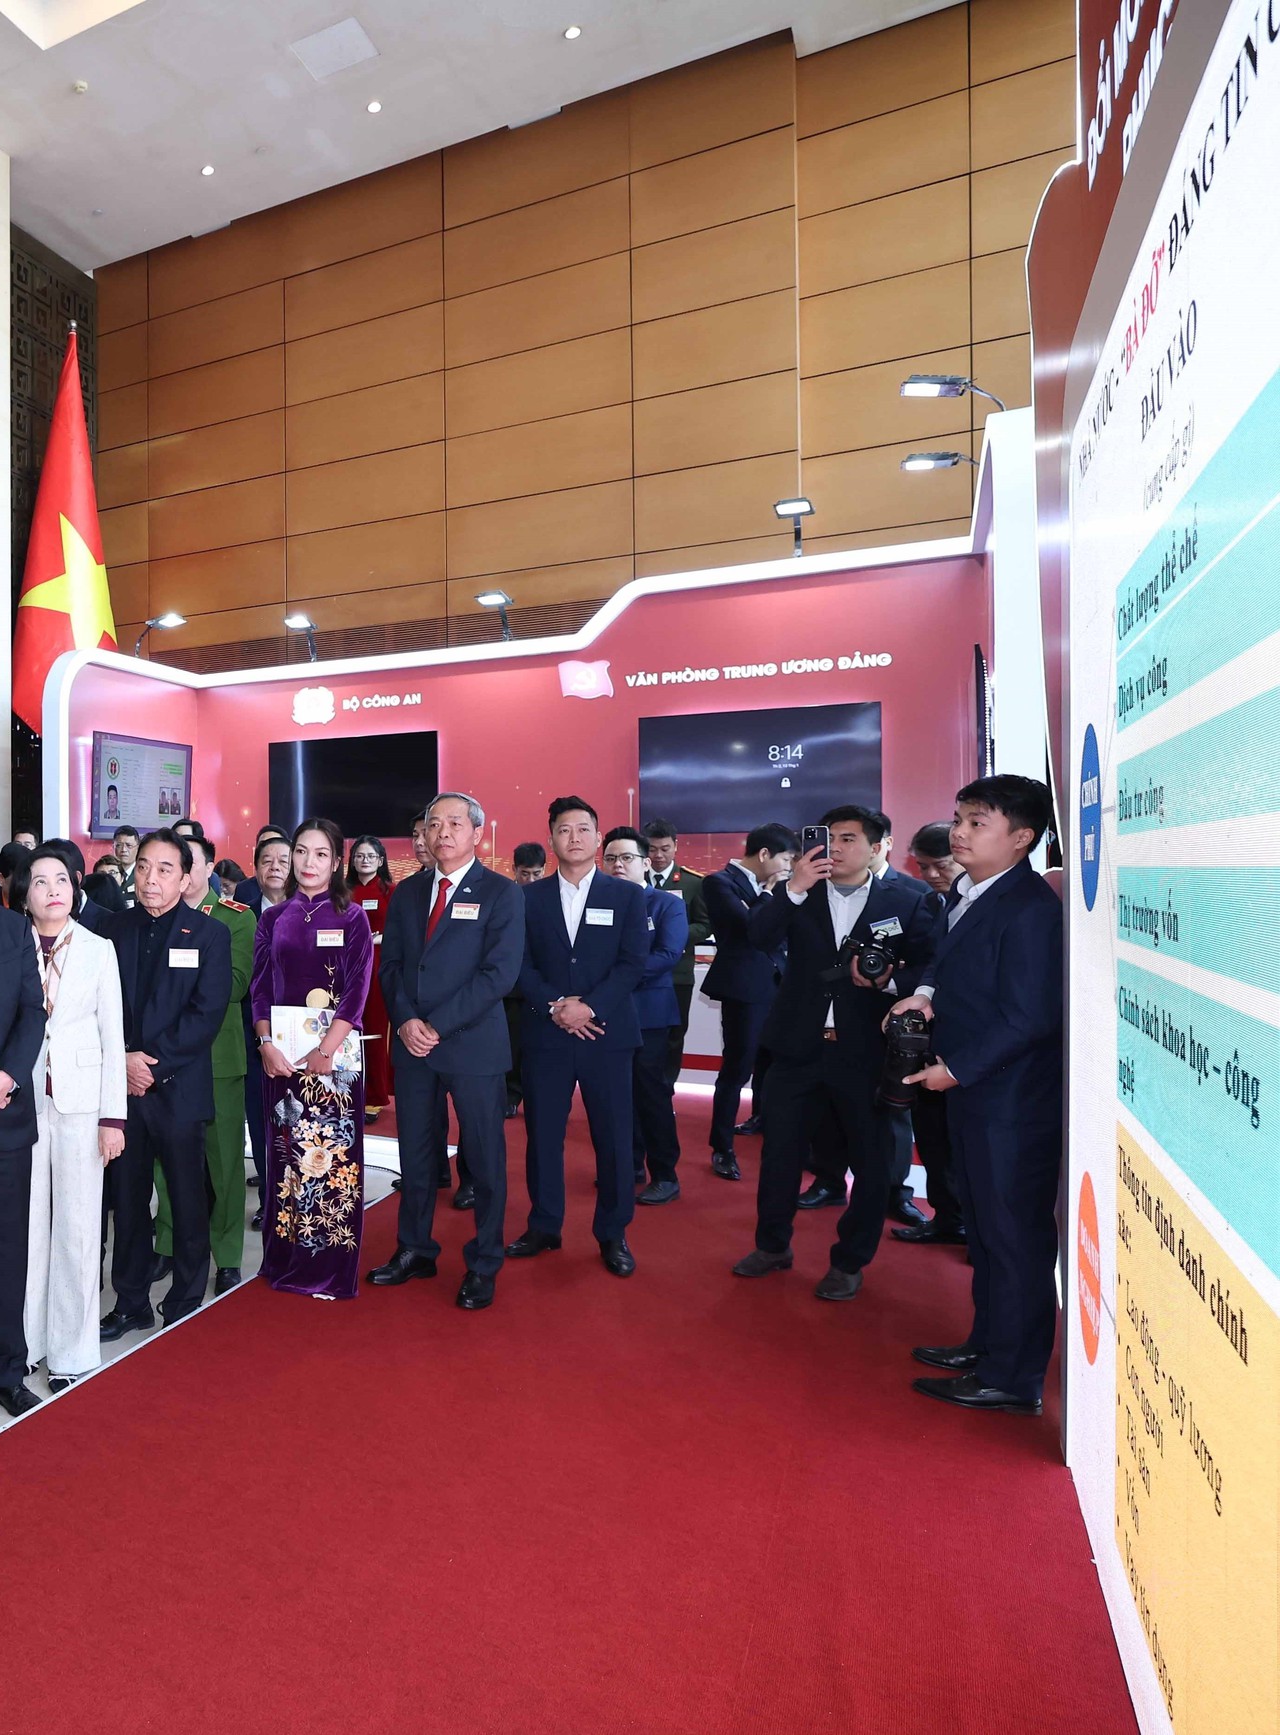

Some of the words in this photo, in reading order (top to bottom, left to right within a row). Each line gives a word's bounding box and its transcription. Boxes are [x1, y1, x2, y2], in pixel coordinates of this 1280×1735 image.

[1093, 367, 1114, 447] NƯỚC
[1220, 6, 1260, 152] TIN
[1167, 299, 1197, 390] VÀO
[1118, 586, 1134, 641] Chất
[1136, 574, 1159, 623] lượng
[1161, 529, 1176, 594] thể
[1179, 501, 1198, 574] chế
[342, 696, 360, 712] BỘ
[361, 694, 401, 709] CÔNG
[402, 692, 422, 706] AN
[625, 671, 658, 687] VĂN
[661, 666, 720, 685] PHÒNG
[722, 662, 778, 680] TRUNG
[781, 657, 834, 675] ƯƠNG
[837, 650, 892, 670] ĐẢNG
[1118, 676, 1134, 723] Dịch
[1135, 675, 1145, 711] vụ
[1147, 654, 1168, 697] công
[768, 744, 804, 761] 8:14
[1118, 778, 1132, 821] Đầu
[1144, 777, 1164, 824] công
[1119, 894, 1130, 937] Thị
[1132, 896, 1159, 948] trường
[1162, 887, 1178, 942] vốn
[1119, 985, 1140, 1029] Chính
[1141, 1000, 1159, 1043] sách
[1162, 1008, 1186, 1062] khoa
[1189, 1024, 1209, 1086] học
[1225, 1048, 1261, 1130] công
[1119, 1056, 1135, 1103] nghệ
[1118, 1144, 1140, 1213] Thông
[1141, 1180, 1152, 1223] tin
[1154, 1196, 1175, 1258] định
[1178, 1229, 1206, 1304] danh
[1209, 1278, 1248, 1367] chính
[1125, 1344, 1139, 1401] Con
[1140, 1386, 1164, 1460] người
[1125, 1403, 1137, 1461] Tài
[1126, 1279, 1139, 1332] Lao
[1140, 1310, 1160, 1385] động
[1168, 1375, 1187, 1437] quỹ
[1189, 1401, 1223, 1517] lương
[1125, 1467, 1139, 1536] Vốn
[1125, 1529, 1139, 1603] Vay
[1140, 1583, 1151, 1639] tín
[1152, 1622, 1174, 1722] dụng
